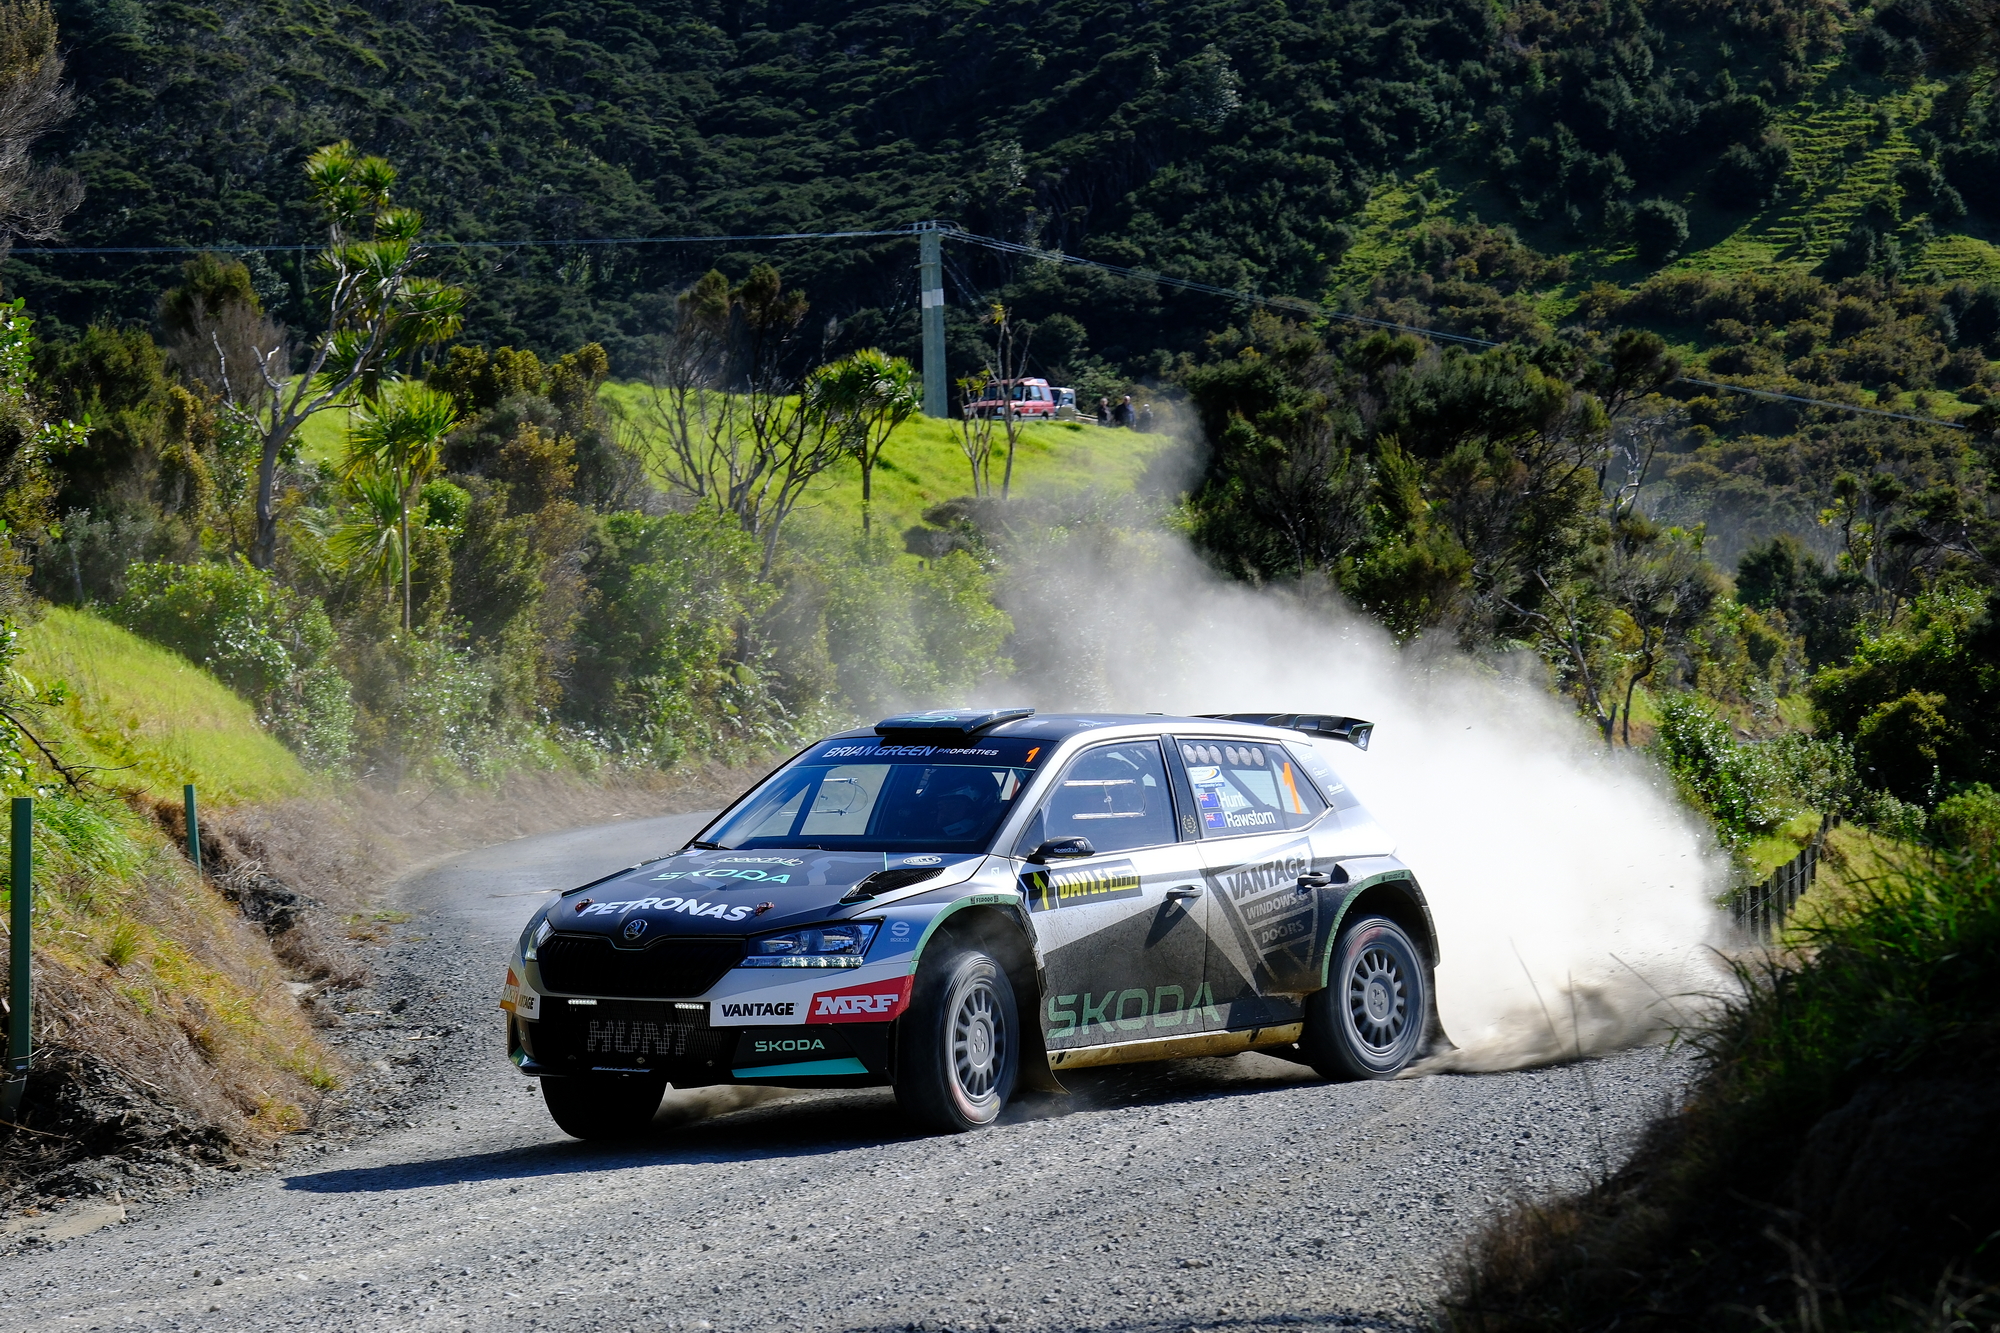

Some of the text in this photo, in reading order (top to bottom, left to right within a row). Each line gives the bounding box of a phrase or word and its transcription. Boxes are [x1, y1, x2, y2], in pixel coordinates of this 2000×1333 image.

[822, 745, 999, 758] BRIAN GREEN PROPERTIES
[1025, 747, 1040, 763] 1
[1217, 790, 1246, 808] Hunt
[1282, 762, 1302, 814] 1
[649, 869, 791, 884] SKODA
[1054, 868, 1108, 899] DAYLE
[1227, 852, 1308, 900] VANTAGE
[1033, 872, 1050, 910] 1
[577, 897, 754, 922] PETRONAS
[1246, 893, 1297, 920] WINDOWS
[1261, 920, 1305, 943] DOORS
[722, 1002, 795, 1017] VANTAGE
[815, 994, 899, 1016] MRF
[1046, 981, 1221, 1040] SKODA
[587, 1020, 694, 1056] HUNT
[755, 1039, 825, 1052] SKODA
